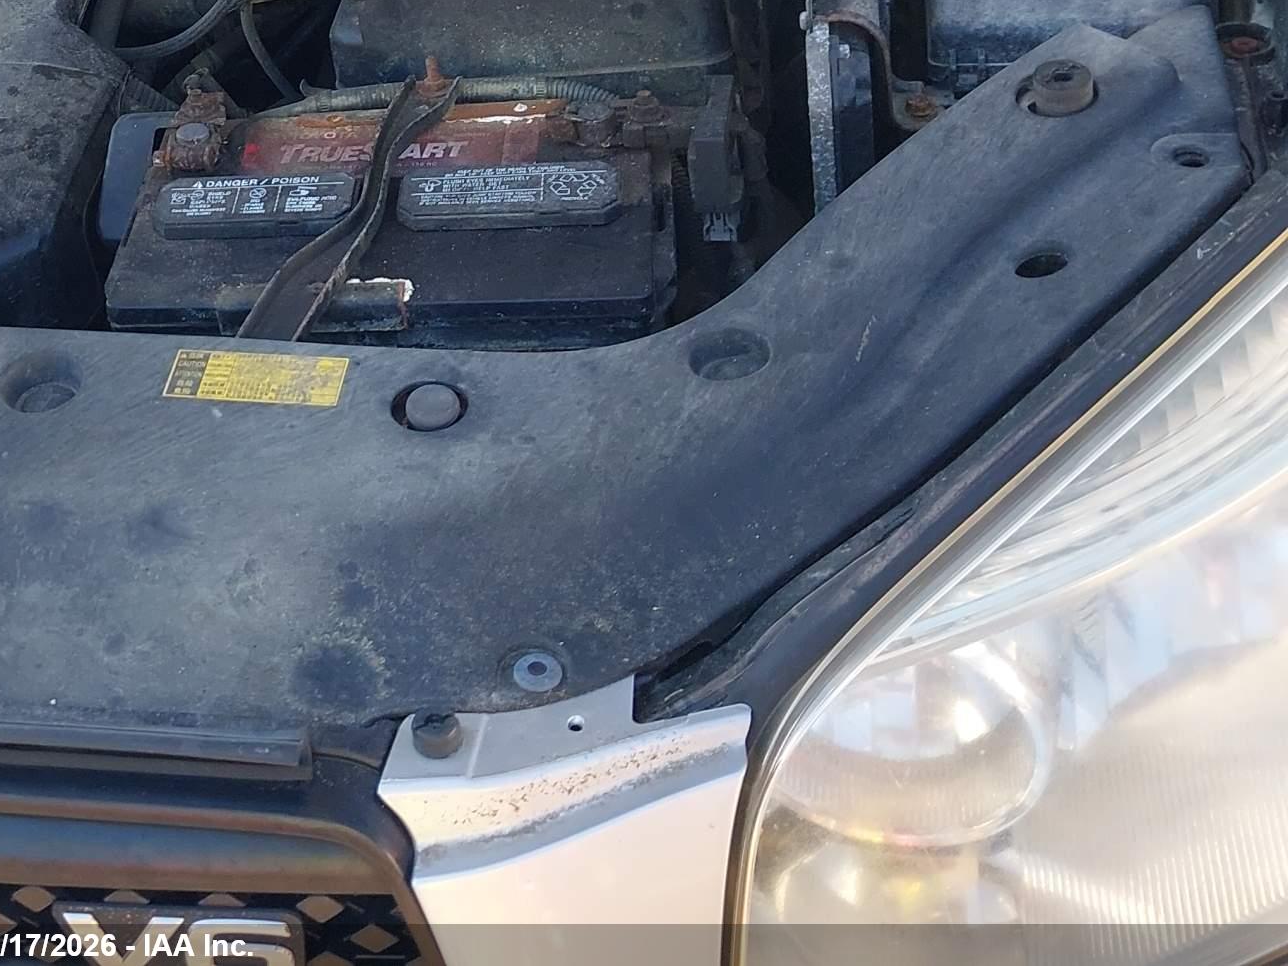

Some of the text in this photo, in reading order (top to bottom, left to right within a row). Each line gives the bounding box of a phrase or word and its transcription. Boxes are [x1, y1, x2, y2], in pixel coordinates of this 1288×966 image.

[280, 140, 469, 164] TRUESART
[205, 178, 259, 188] DANGER
[271, 176, 320, 185] POISON
[62, 912, 296, 966] V6
